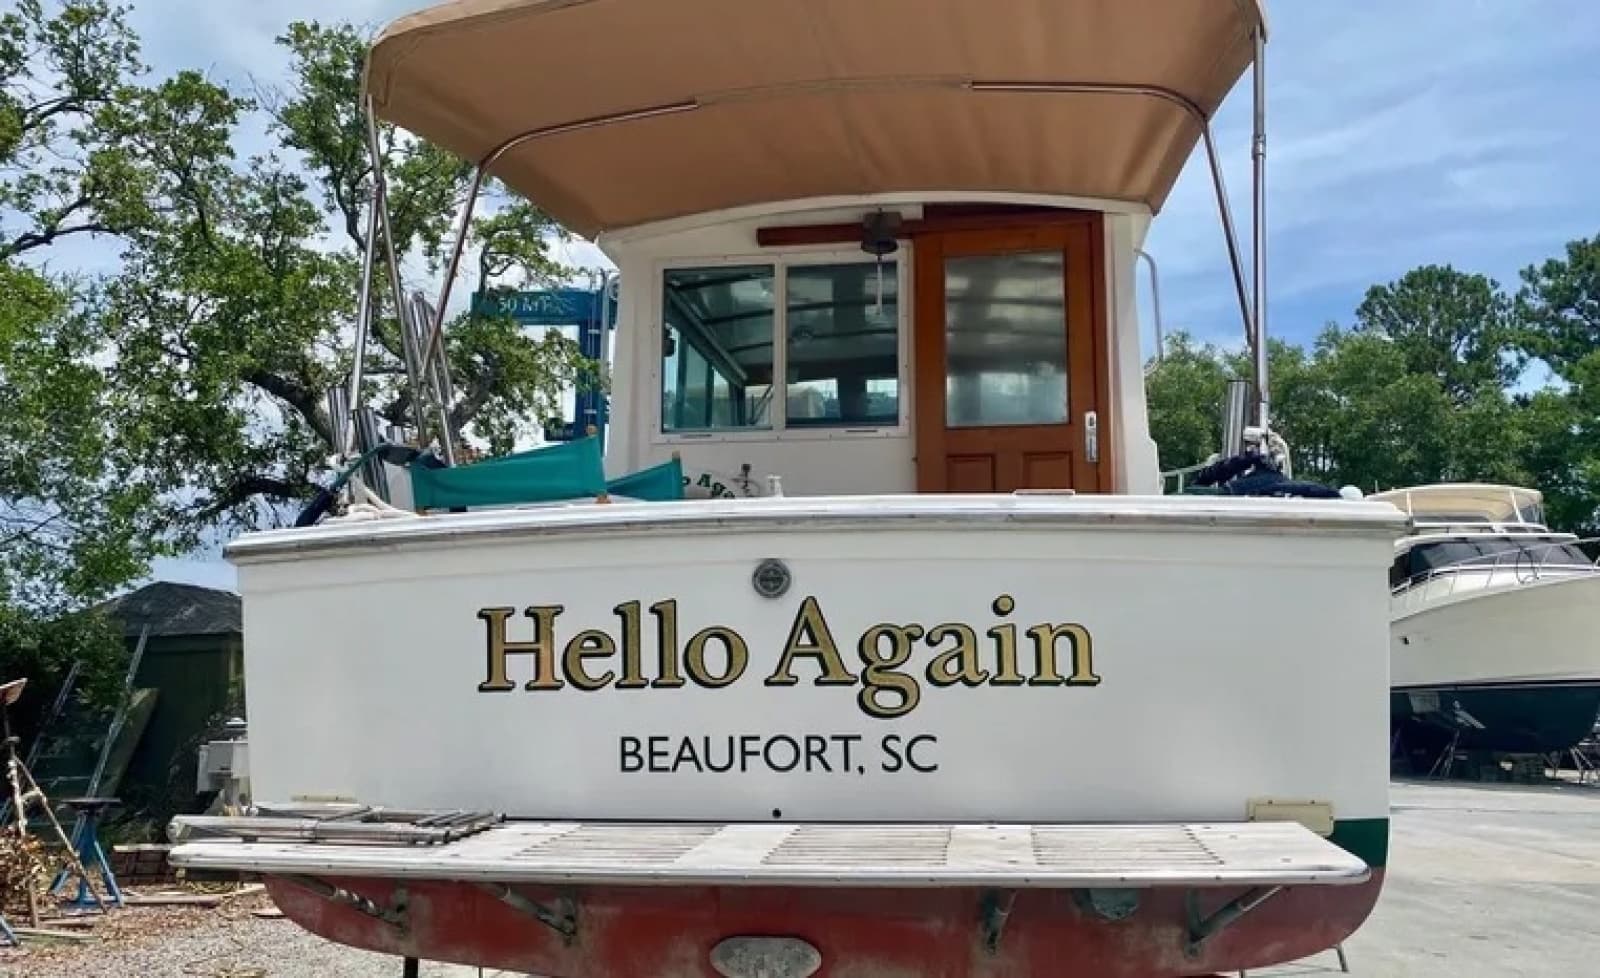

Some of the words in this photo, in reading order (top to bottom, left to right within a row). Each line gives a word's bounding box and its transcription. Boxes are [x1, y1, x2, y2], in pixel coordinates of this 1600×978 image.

[477, 599, 749, 693] Hello
[763, 594, 1101, 719] Again
[620, 735, 865, 775] BEAUFORT,
[882, 734, 938, 773] SC
